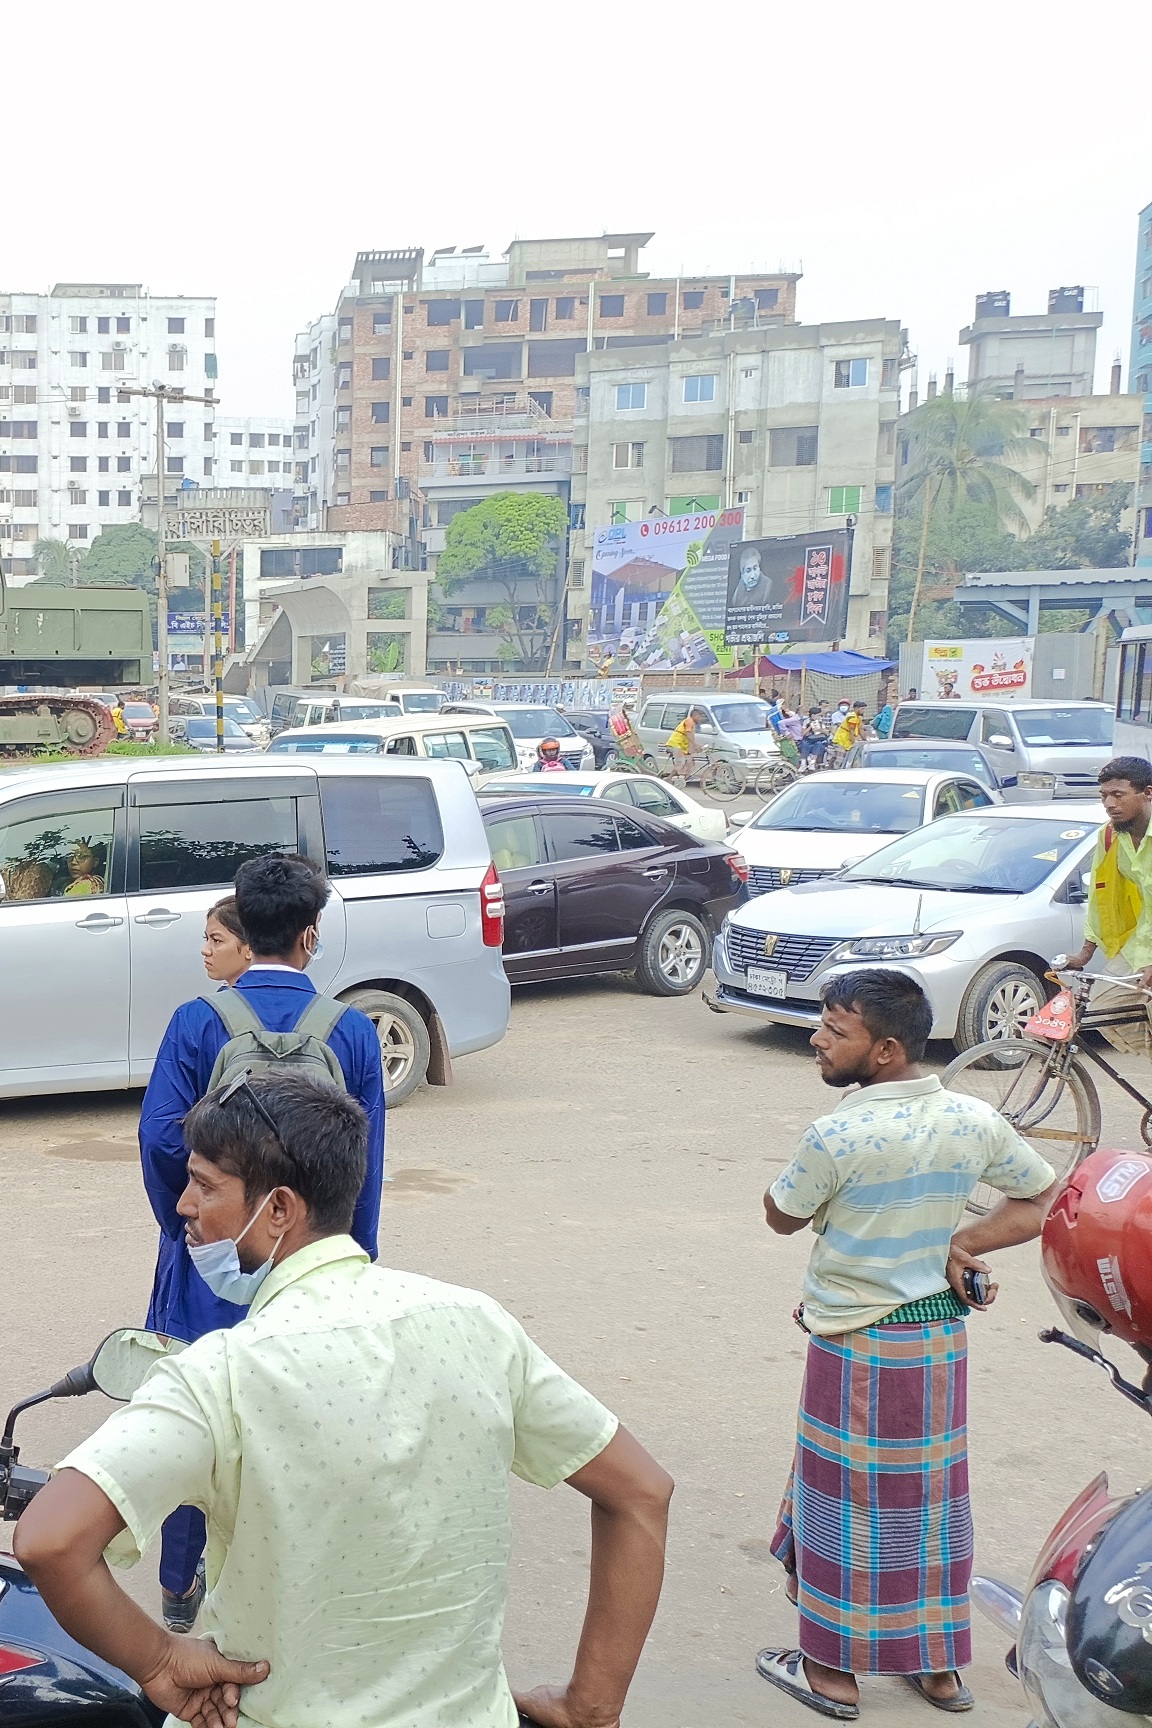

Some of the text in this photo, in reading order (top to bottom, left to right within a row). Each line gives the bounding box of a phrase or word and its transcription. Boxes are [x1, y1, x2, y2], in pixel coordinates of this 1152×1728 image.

[654, 511, 742, 535] 09612 200 300
[974, 672, 1025, 689] শুভ উদ্বোধন
